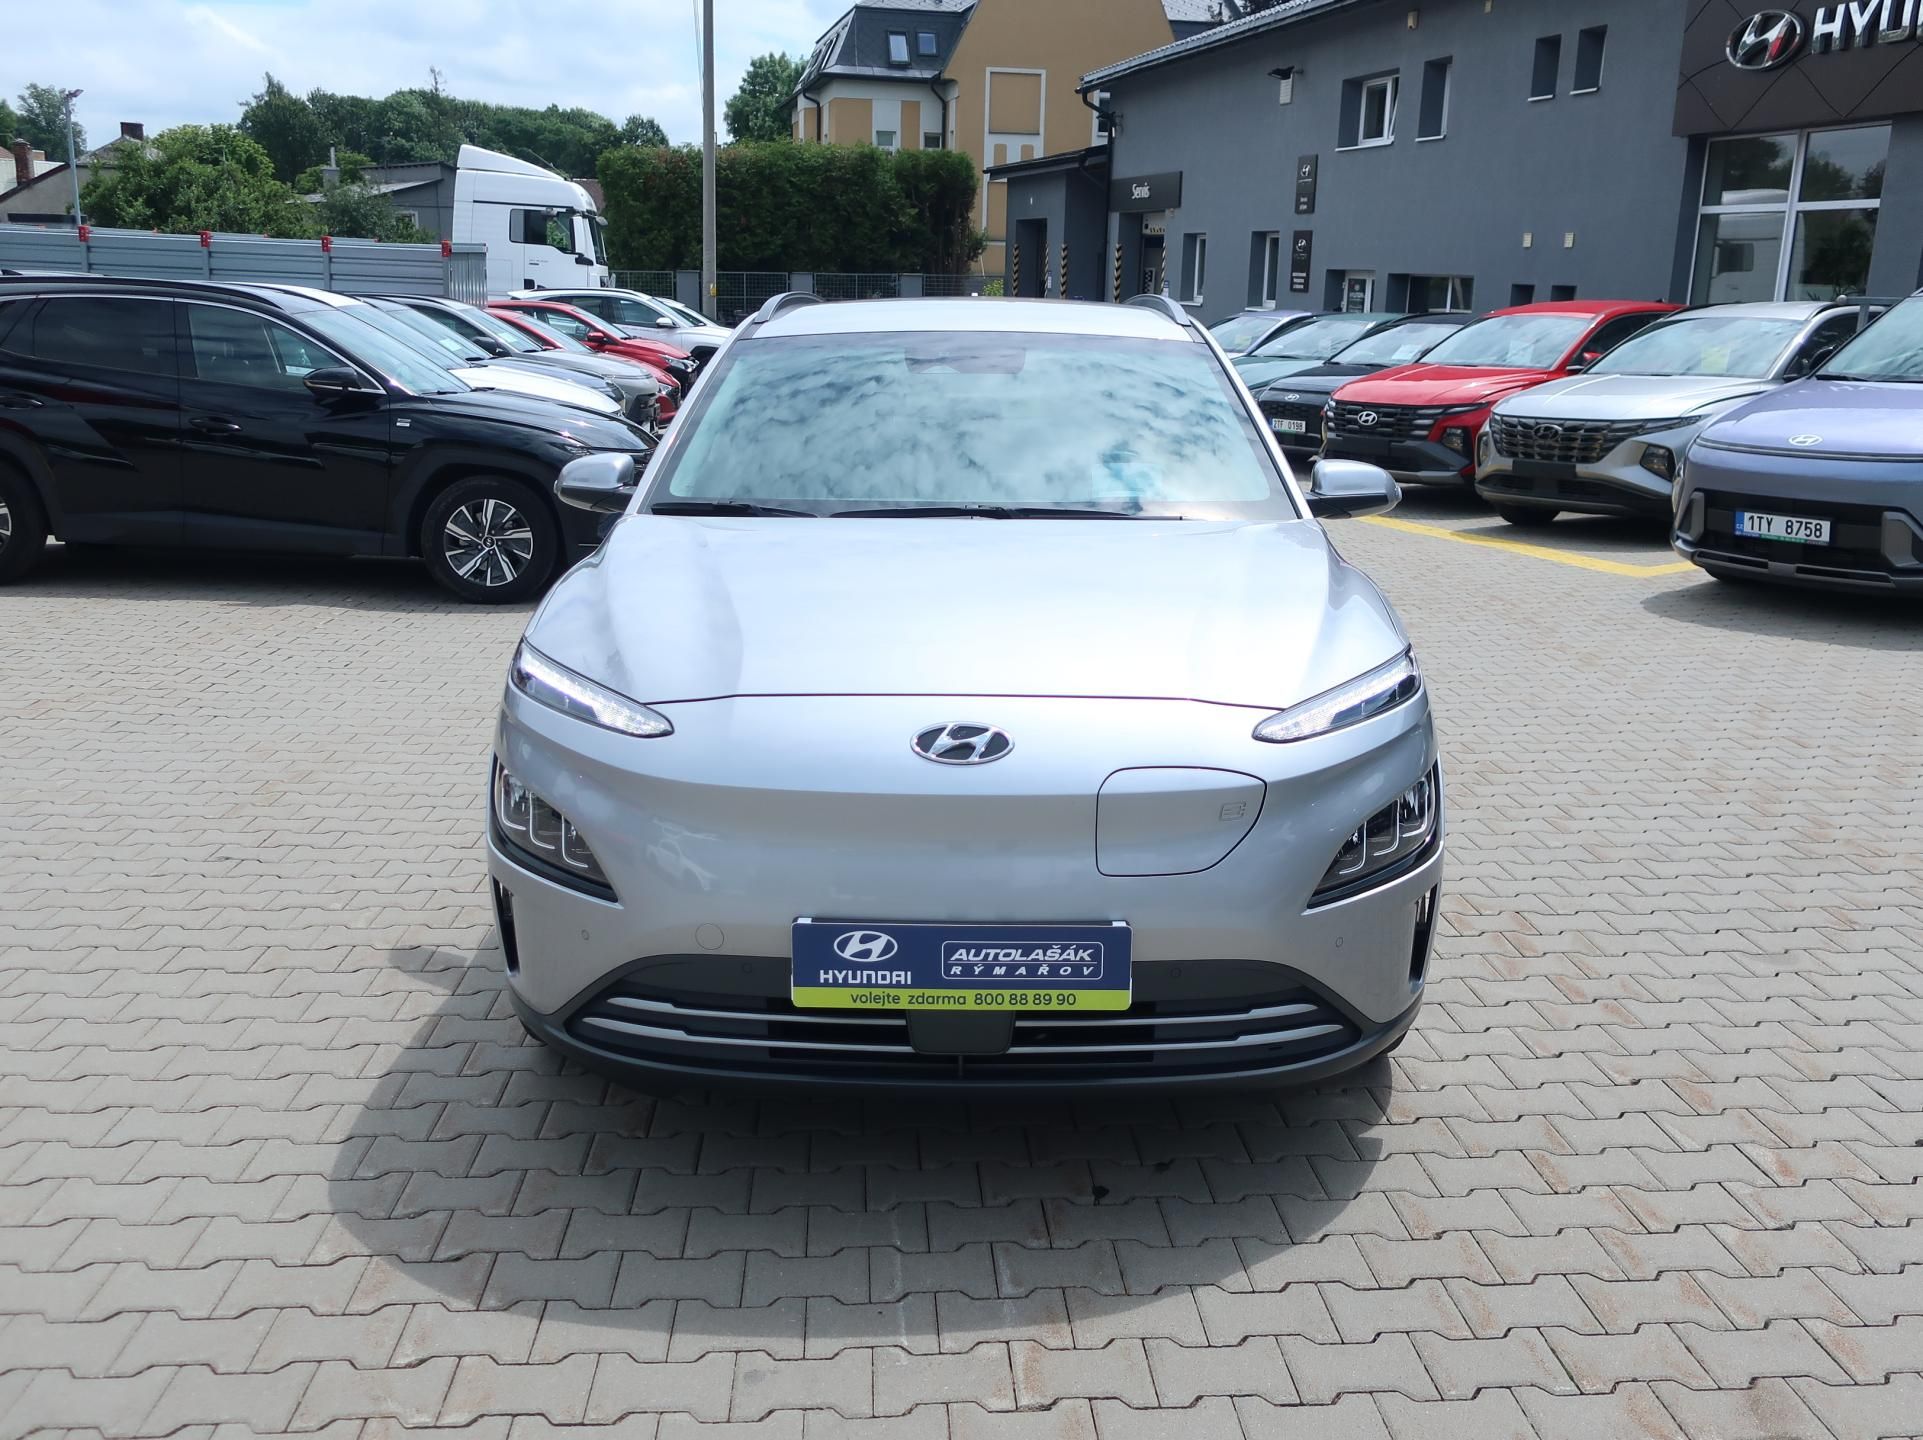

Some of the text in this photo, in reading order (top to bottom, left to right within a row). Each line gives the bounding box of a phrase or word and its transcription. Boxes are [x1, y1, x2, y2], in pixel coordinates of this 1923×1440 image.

[1812, 0, 1923, 54] HYU
[1748, 515, 1773, 533] 1TY
[1785, 519, 1823, 539] 8758
[950, 944, 1095, 961] AUTOLAŠÁK
[819, 969, 912, 985] HYUNDAI
[850, 991, 1077, 1007] volejte zdarma 800 88 89 90
